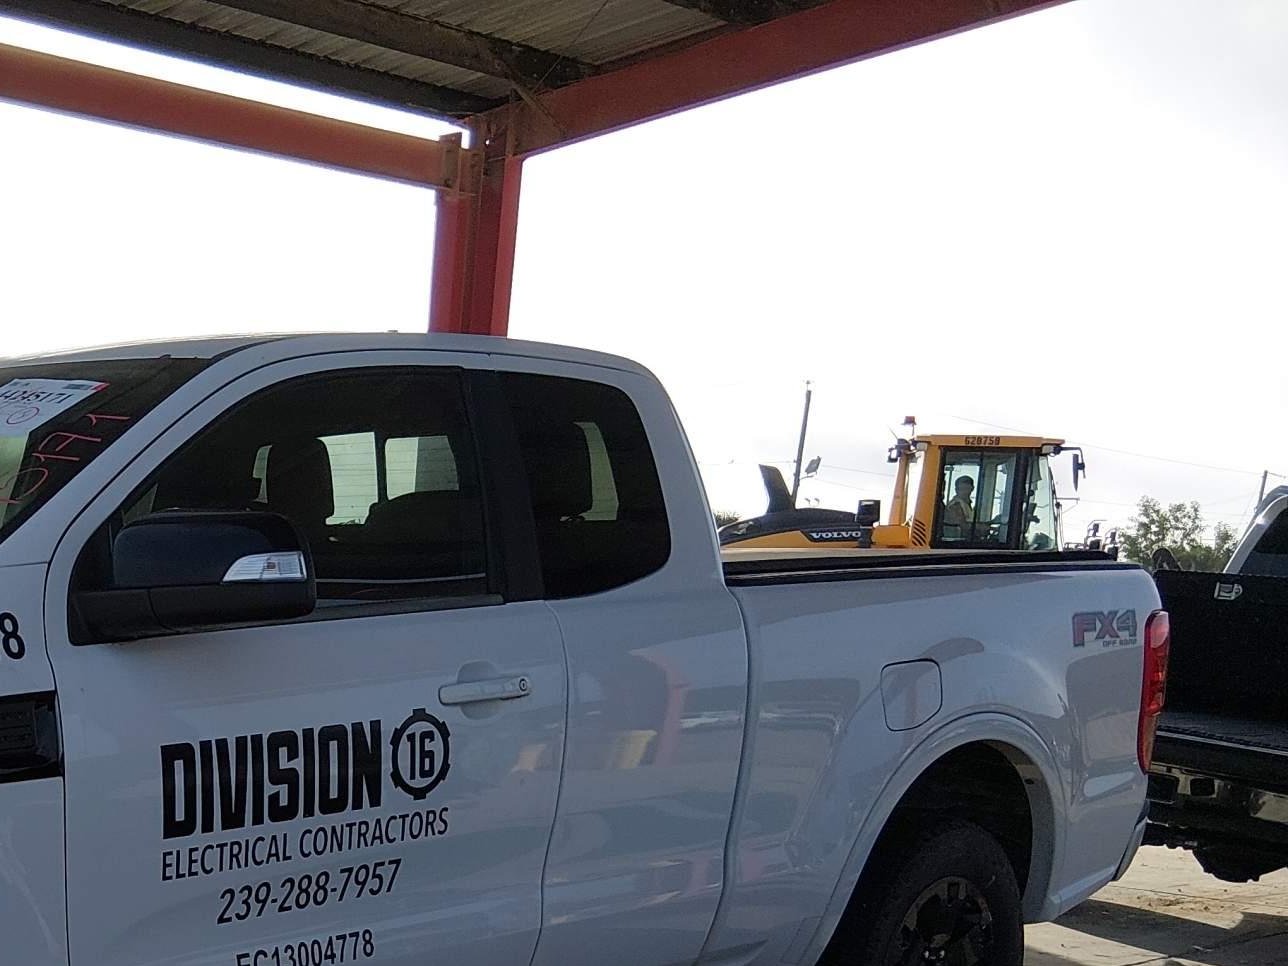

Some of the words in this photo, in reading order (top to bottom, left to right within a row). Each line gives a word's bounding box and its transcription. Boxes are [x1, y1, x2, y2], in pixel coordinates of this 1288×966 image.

[810, 531, 862, 539] VOLVO
[1072, 609, 1137, 647] FX4
[160, 719, 382, 839] DIVISION
[406, 731, 436, 780] 16
[161, 832, 292, 882] ELECTRICAL
[299, 806, 449, 859] CONTRACTORS
[217, 858, 402, 925] 239-288-7957
